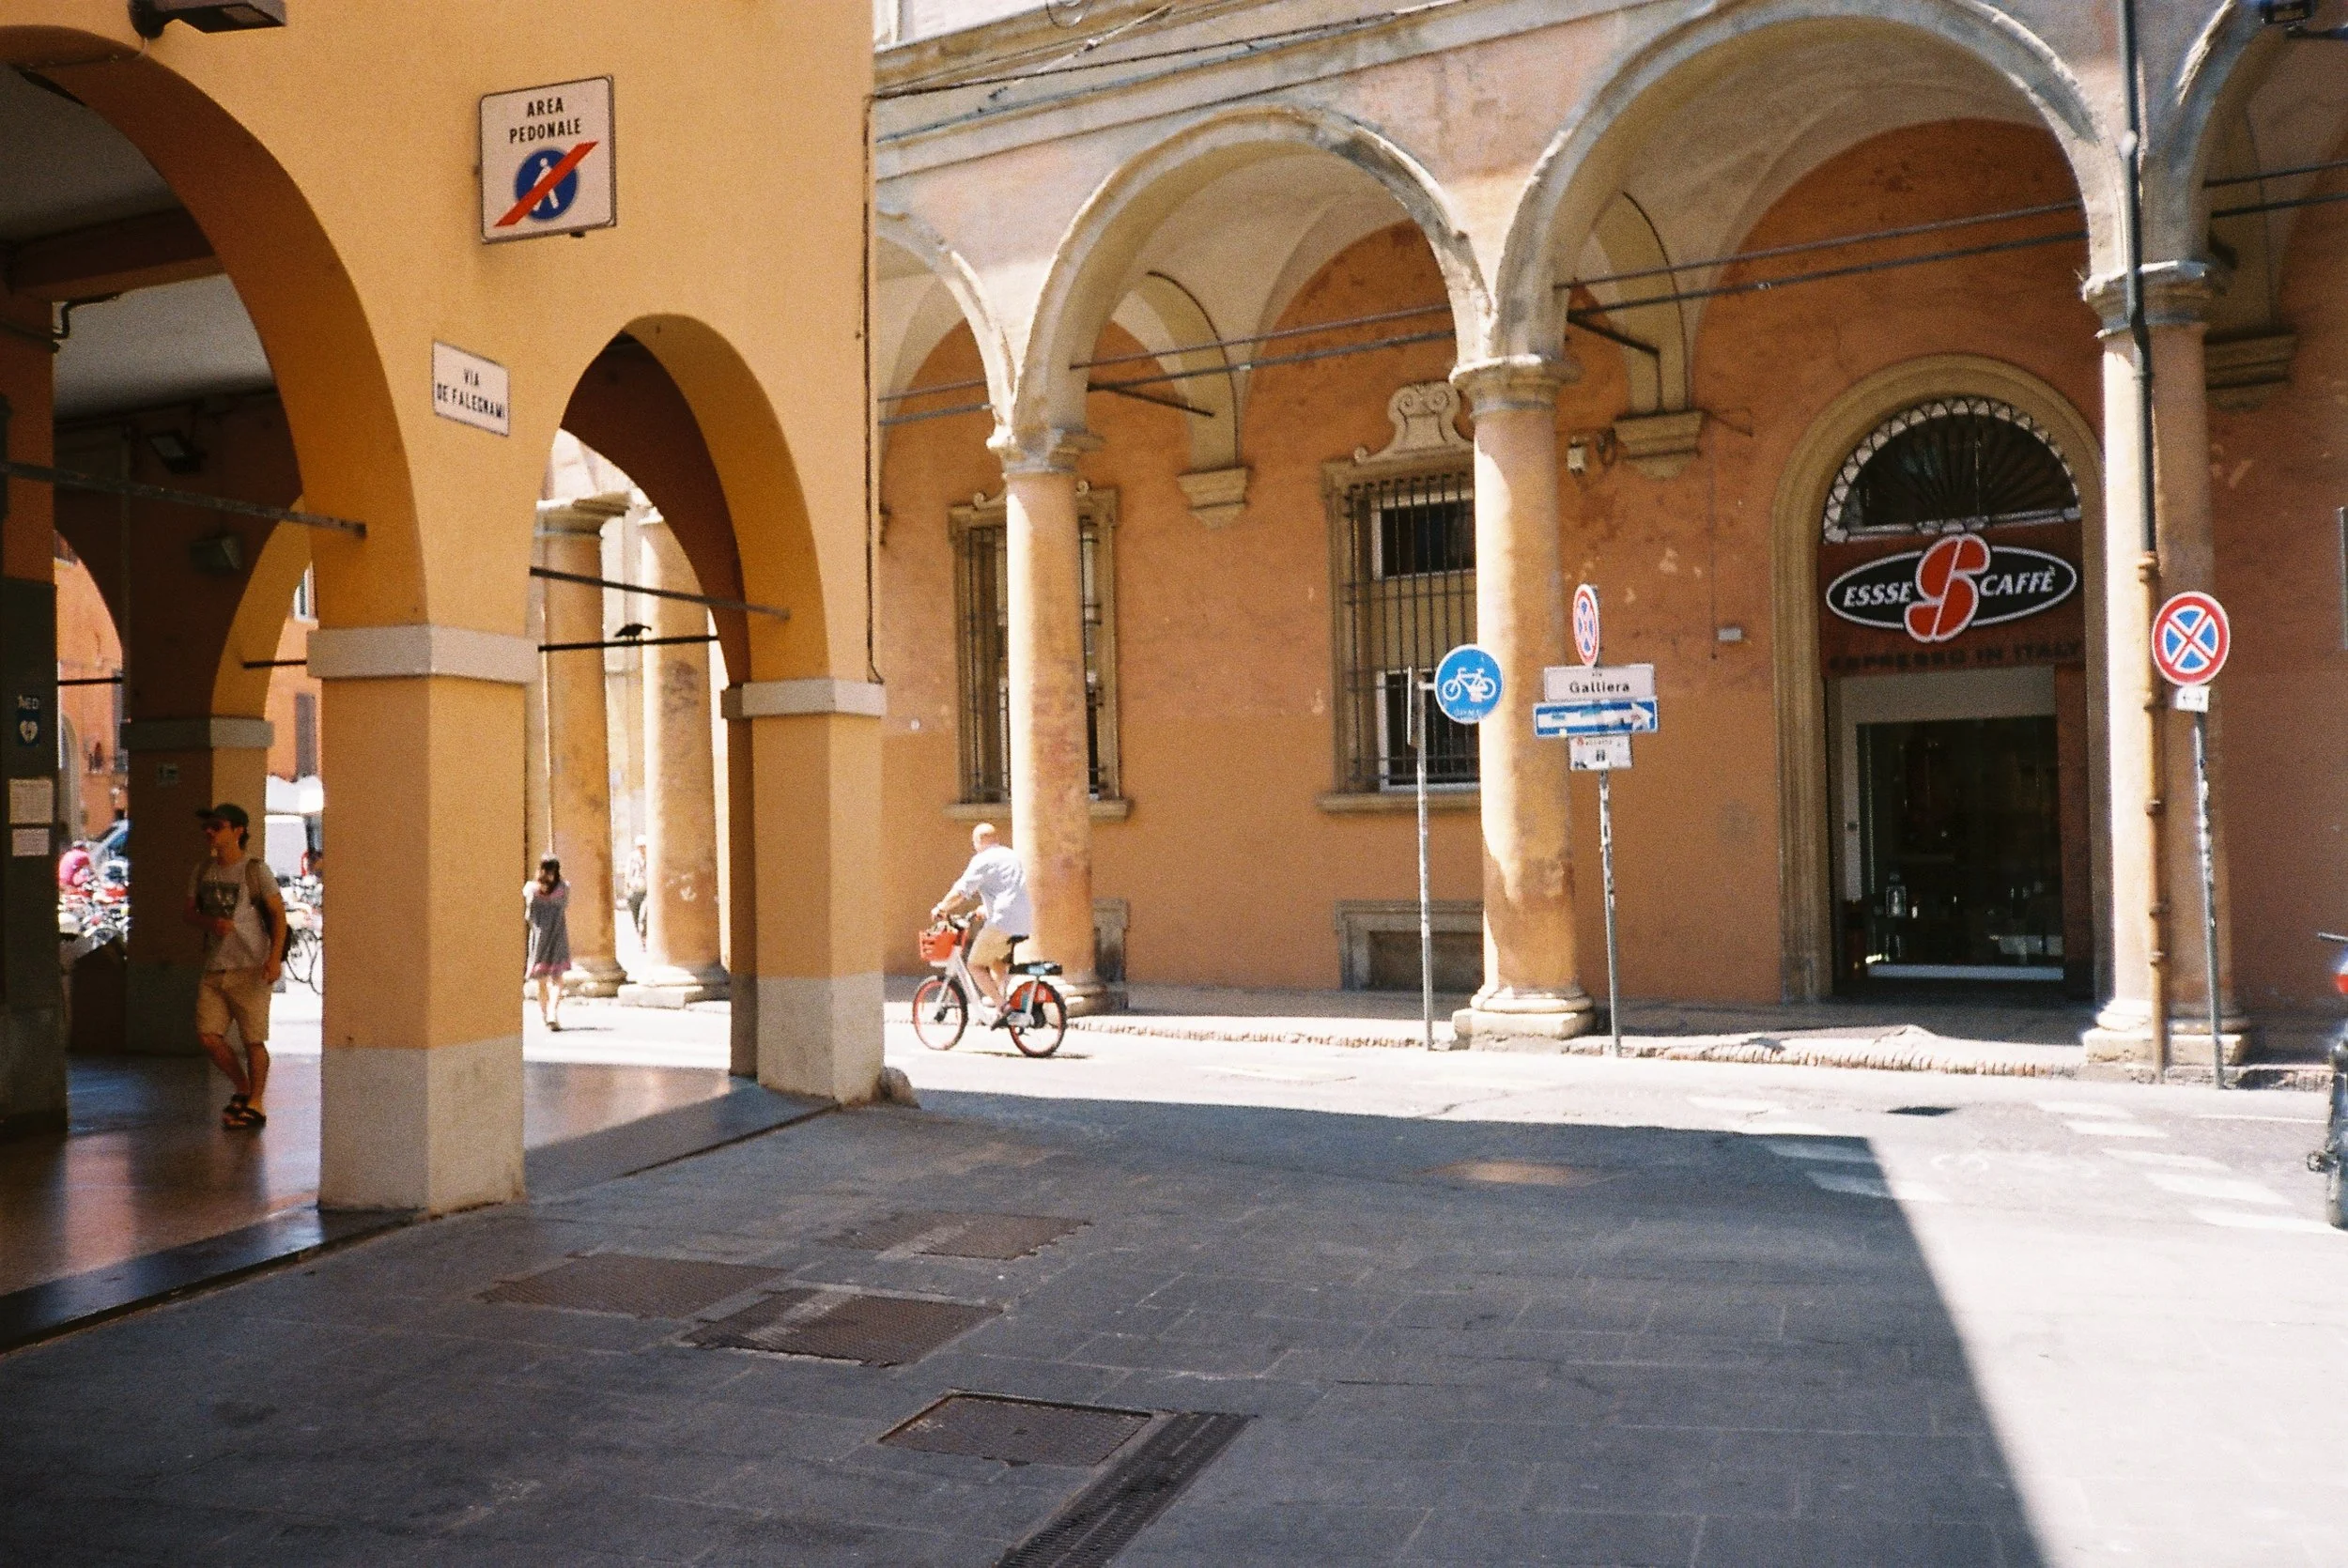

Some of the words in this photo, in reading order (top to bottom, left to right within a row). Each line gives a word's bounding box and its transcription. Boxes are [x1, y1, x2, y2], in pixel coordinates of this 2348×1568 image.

[527, 97, 564, 117] AREA
[509, 117, 581, 144] PEDONALE
[464, 367, 479, 386] VIA
[453, 388, 505, 420] FALEGNAMI
[1843, 581, 1914, 607] ESSSE
[1979, 565, 2056, 596] CAFFÈ
[1569, 681, 1630, 694] Galliera
